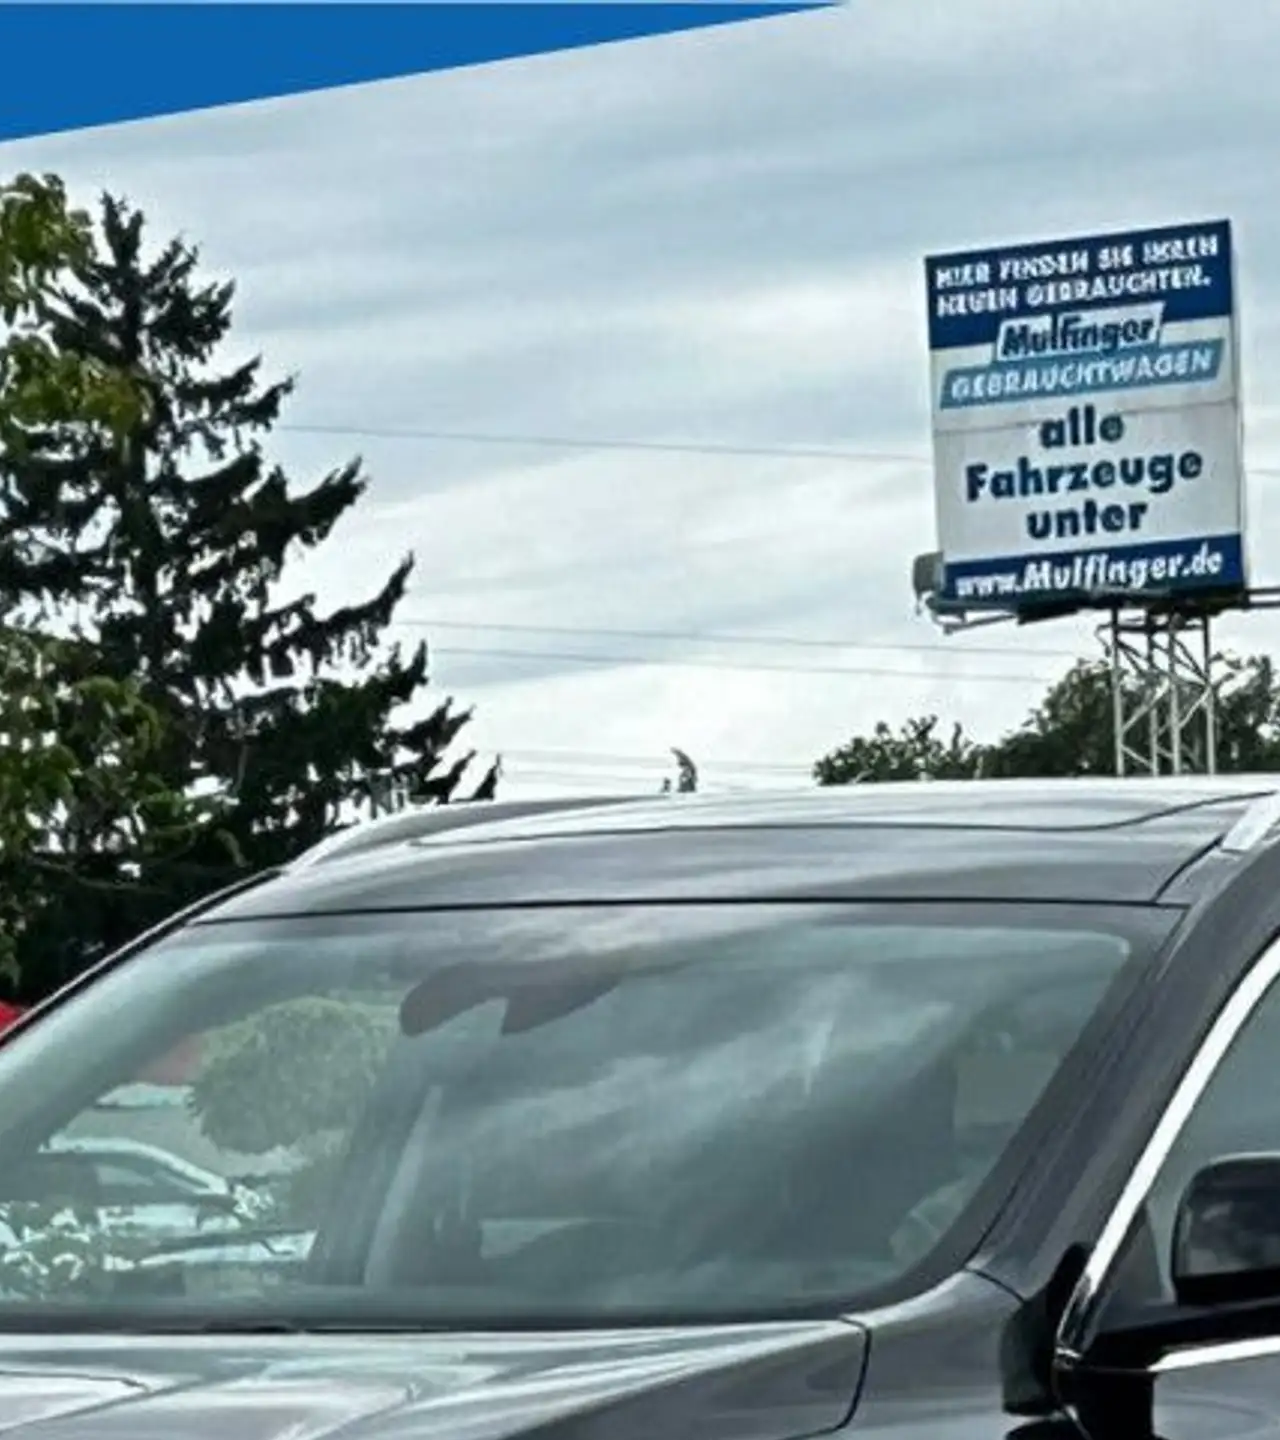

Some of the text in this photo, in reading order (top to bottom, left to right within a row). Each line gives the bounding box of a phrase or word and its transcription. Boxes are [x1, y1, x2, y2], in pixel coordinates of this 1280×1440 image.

[1000, 317, 1156, 357] Mulfinger
[950, 348, 1214, 401] GEBRAUCHTWAGEN
[1039, 404, 1125, 448] alle
[966, 450, 1204, 502] Fahrzeuge
[1026, 501, 1149, 540] unter
[955, 542, 1224, 596] www.Mulfinger.de
